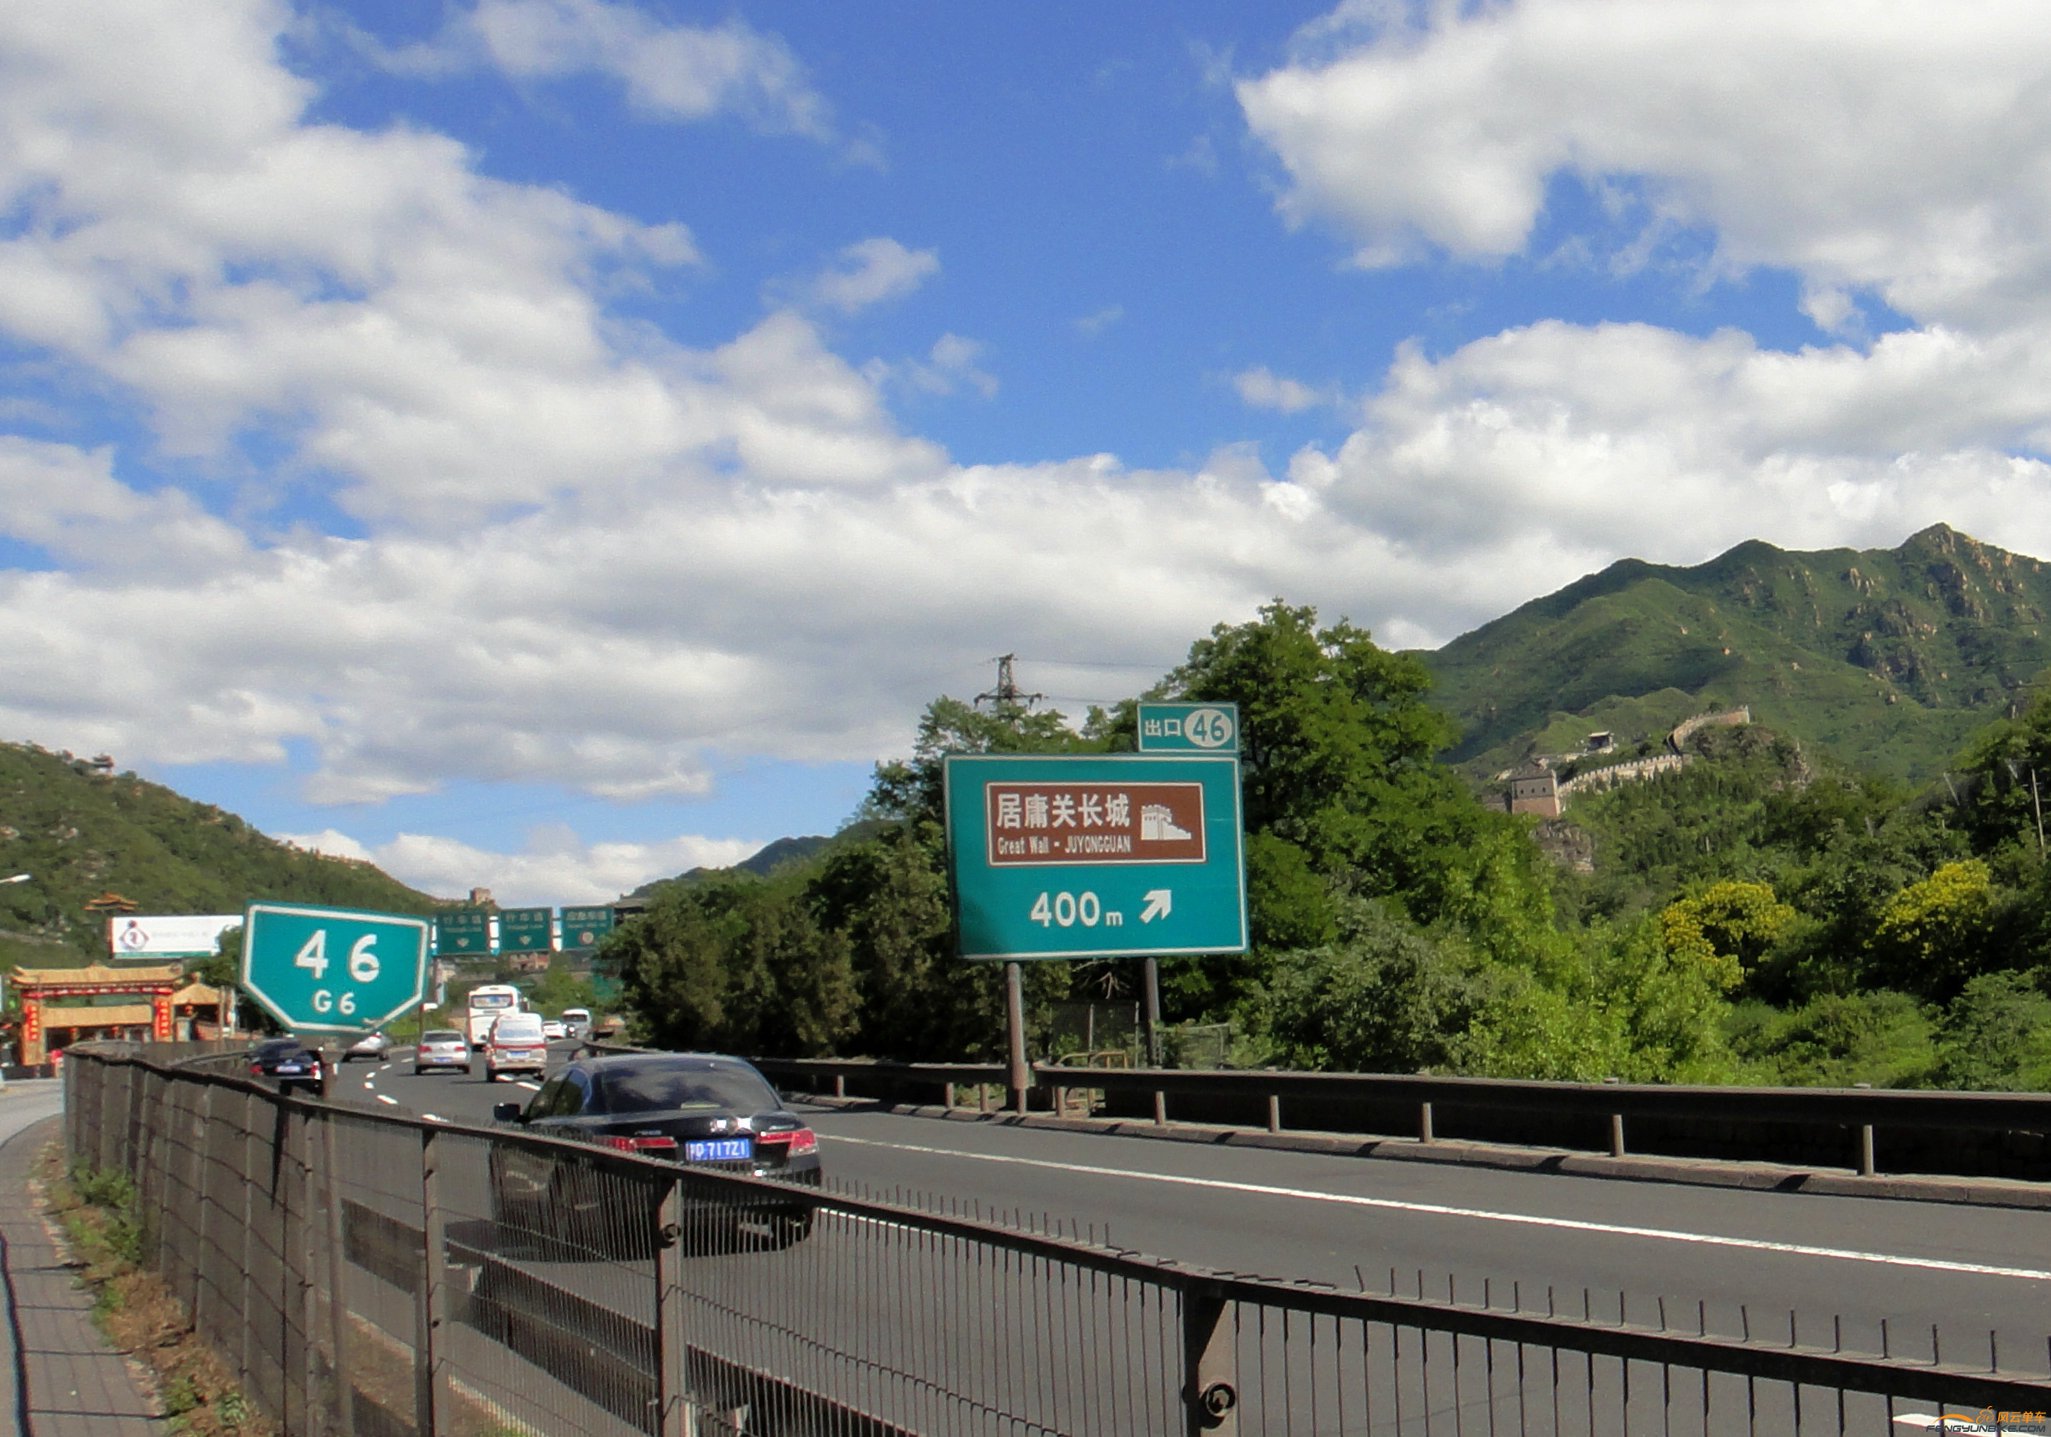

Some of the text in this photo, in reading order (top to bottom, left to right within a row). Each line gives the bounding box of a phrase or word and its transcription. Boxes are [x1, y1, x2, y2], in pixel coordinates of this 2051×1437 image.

[1144, 714, 1226, 741] 出口 46
[996, 792, 1131, 830] 居庸关长城
[997, 836, 1025, 855] Great
[1029, 836, 1050, 854] Wall
[1064, 835, 1132, 854] JUYONGGUAN
[312, 989, 356, 1015] G6
